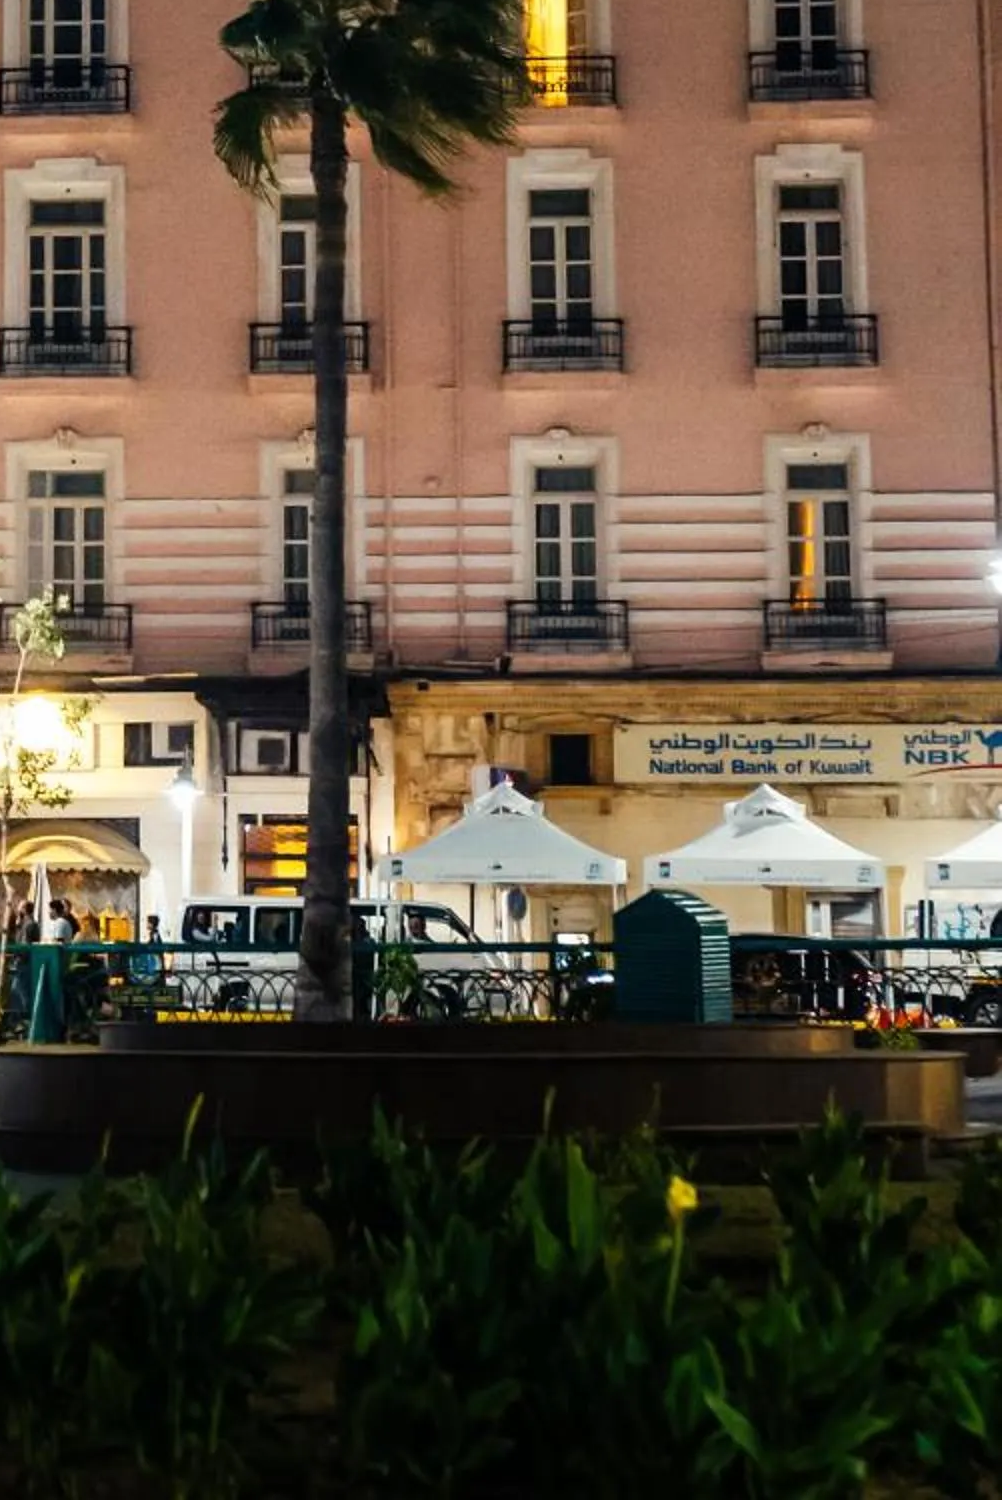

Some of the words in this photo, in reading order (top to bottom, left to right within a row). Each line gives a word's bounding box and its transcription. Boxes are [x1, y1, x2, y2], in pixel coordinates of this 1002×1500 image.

[649, 733, 730, 755] الوطني
[732, 733, 816, 755] الكويت
[819, 734, 872, 754] بنك
[904, 729, 972, 749] الوطني
[649, 758, 724, 775] National
[731, 759, 778, 775] Bank
[784, 760, 802, 774] of
[809, 759, 873, 775] Kuwait
[904, 750, 970, 765] NBK
